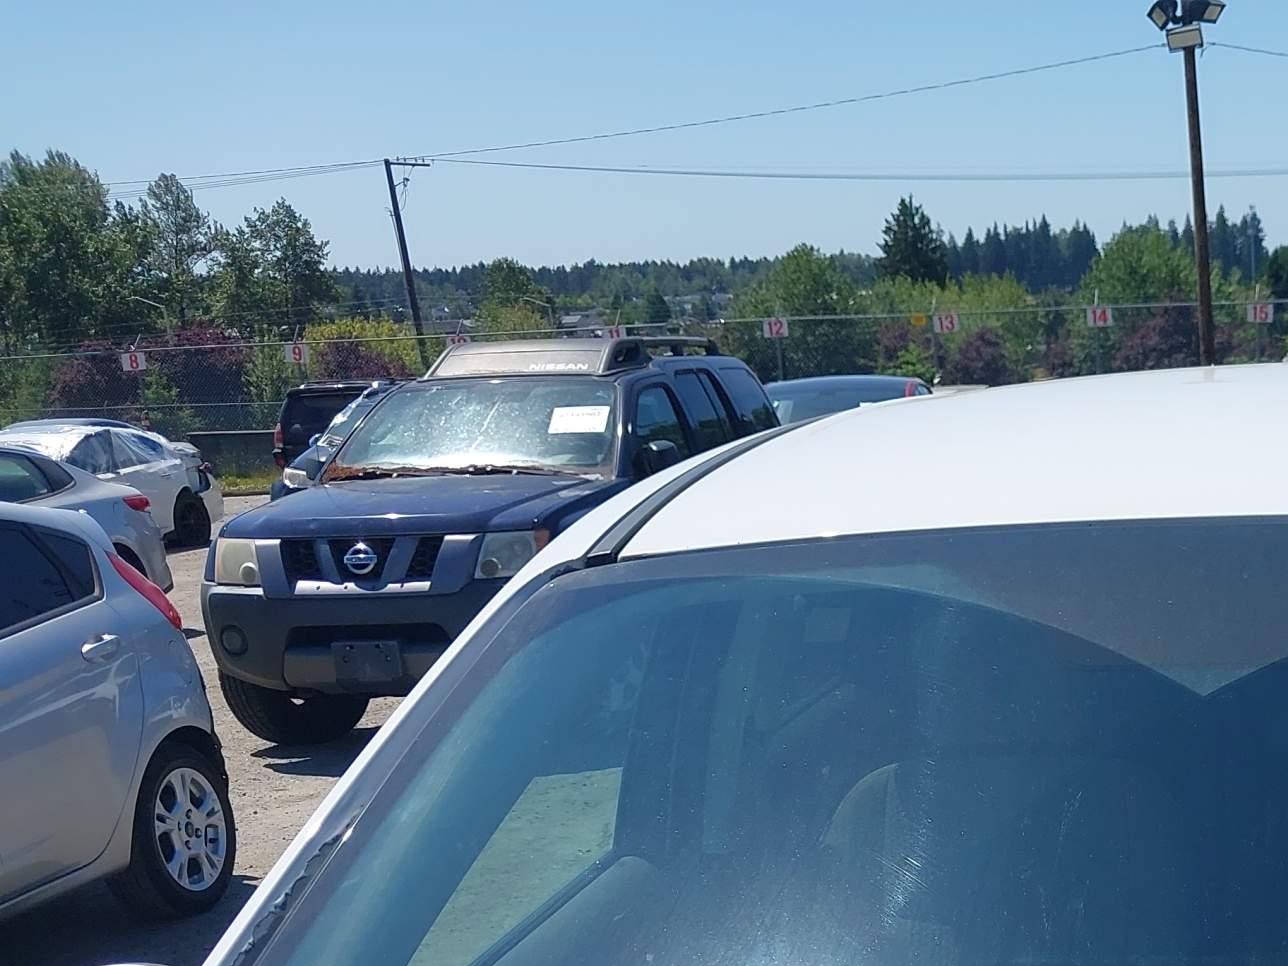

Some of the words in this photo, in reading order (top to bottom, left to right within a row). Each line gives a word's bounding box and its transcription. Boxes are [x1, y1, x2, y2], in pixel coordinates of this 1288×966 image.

[1092, 307, 1109, 325] 14
[1253, 304, 1269, 321] 15
[768, 319, 784, 336] 12
[938, 314, 955, 330] 13
[129, 353, 139, 369] 8
[292, 345, 302, 361] 9
[528, 363, 588, 371] NISSAN
